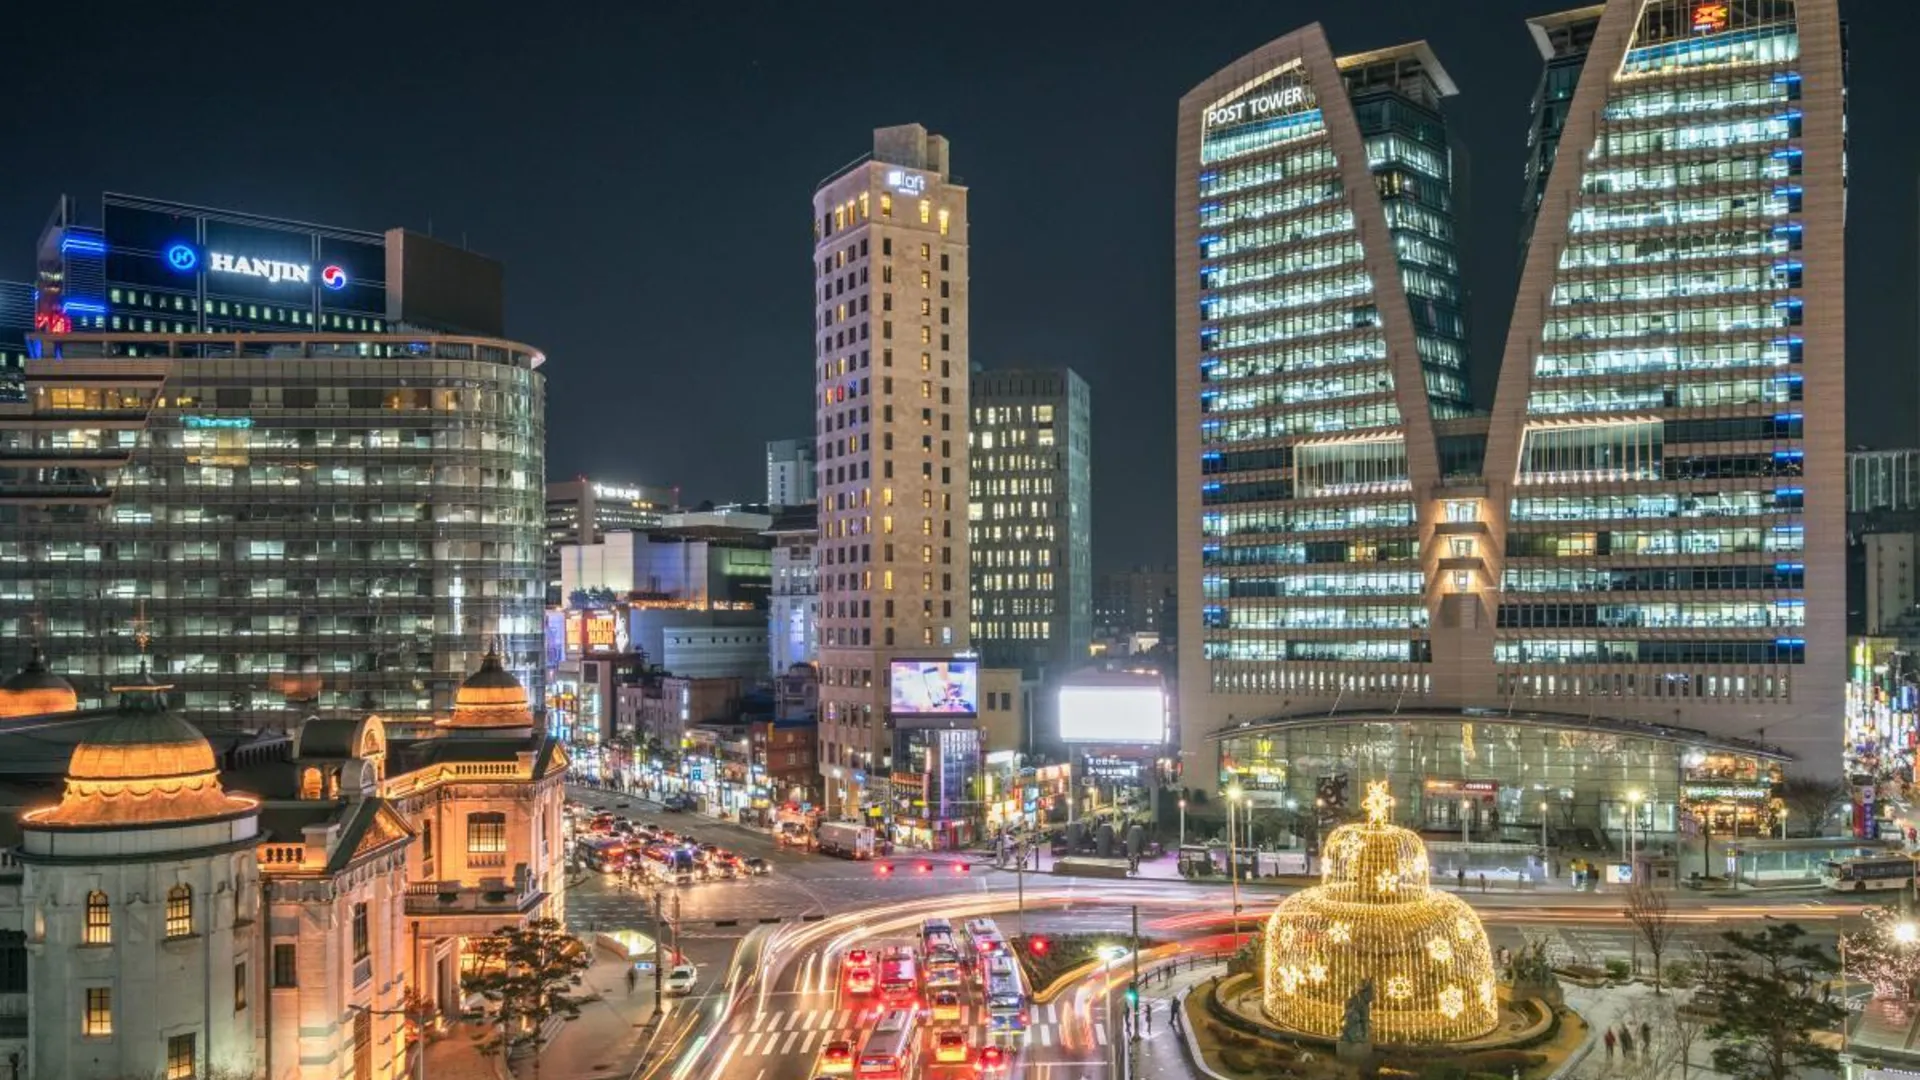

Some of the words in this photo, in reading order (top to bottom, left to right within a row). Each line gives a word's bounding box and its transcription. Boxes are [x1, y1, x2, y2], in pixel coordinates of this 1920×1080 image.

[1208, 102, 1245, 127] POST
[1249, 87, 1302, 116] TOWER
[889, 171, 925, 191] loft
[211, 252, 311, 283] HANJIN
